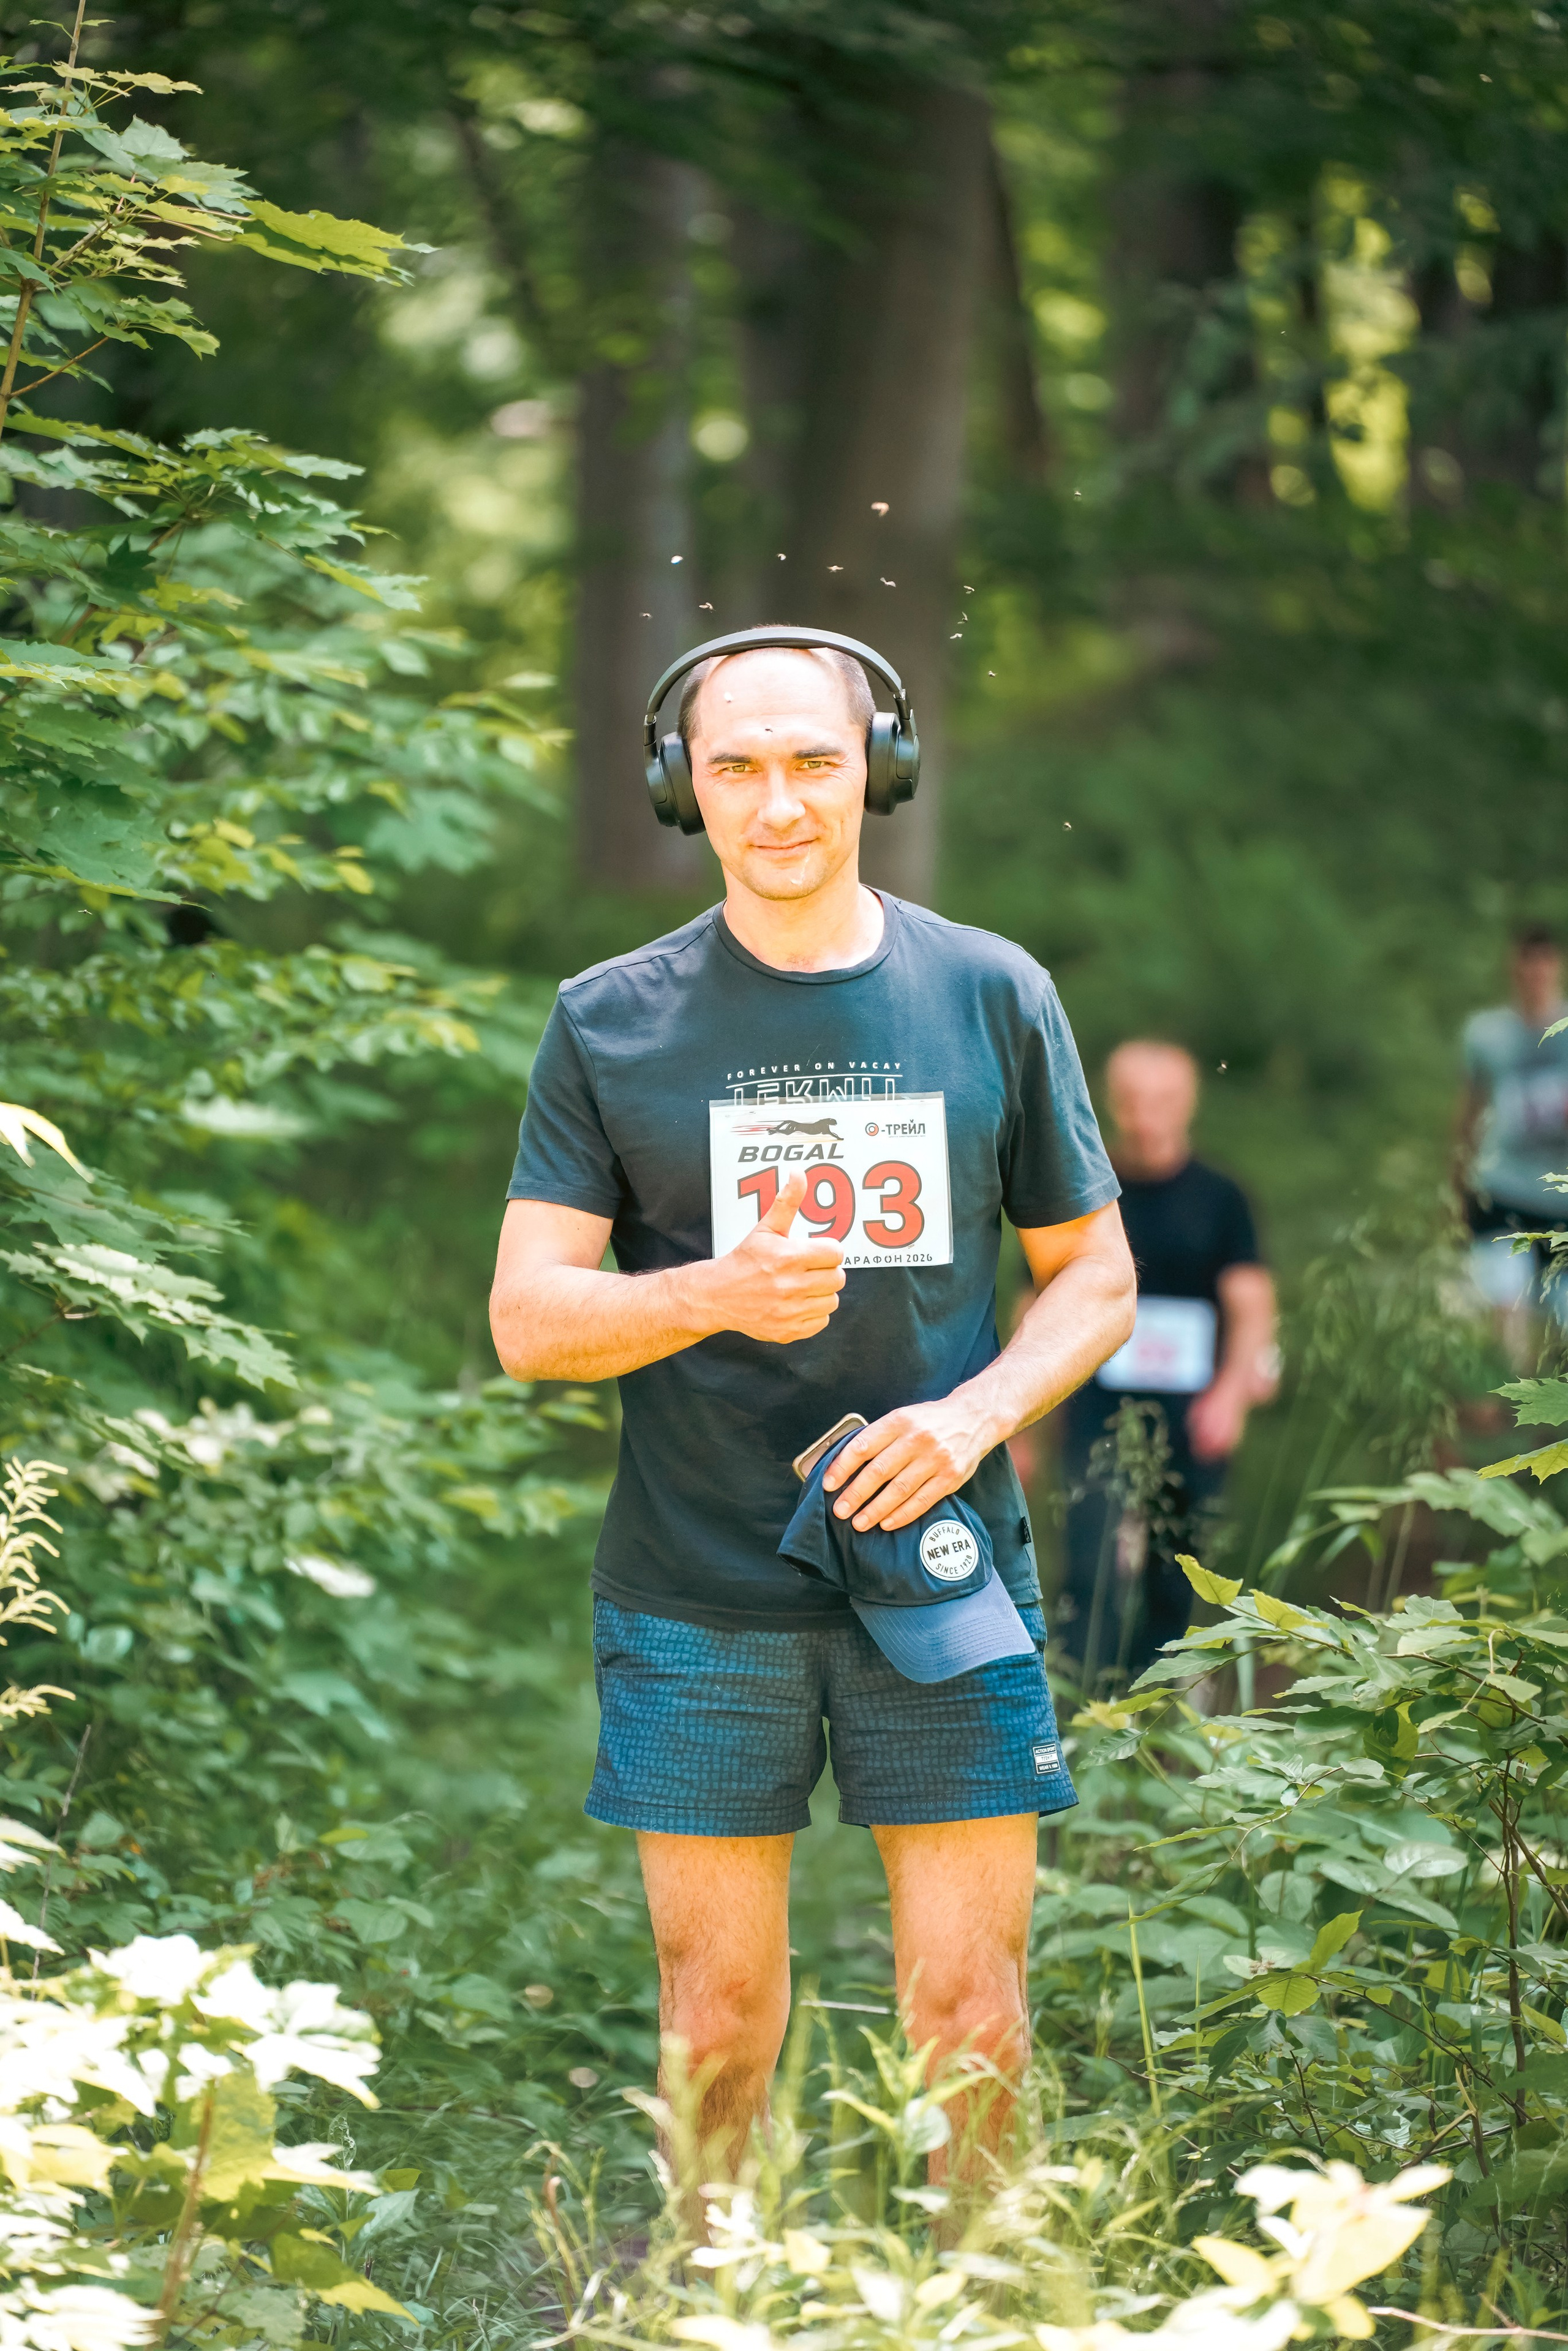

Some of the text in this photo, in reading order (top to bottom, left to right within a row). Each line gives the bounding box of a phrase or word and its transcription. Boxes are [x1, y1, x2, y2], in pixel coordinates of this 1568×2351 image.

[727, 1061, 901, 1080] FOREVER ON VACAY
[737, 1143, 845, 1163] BOGAL
[839, 1253, 933, 1266] АРАФОН 2026
[929, 1526, 960, 1542] BUFFALO
[927, 1539, 971, 1560] NEW ERA
[935, 1555, 973, 1575] SINCE 1920
